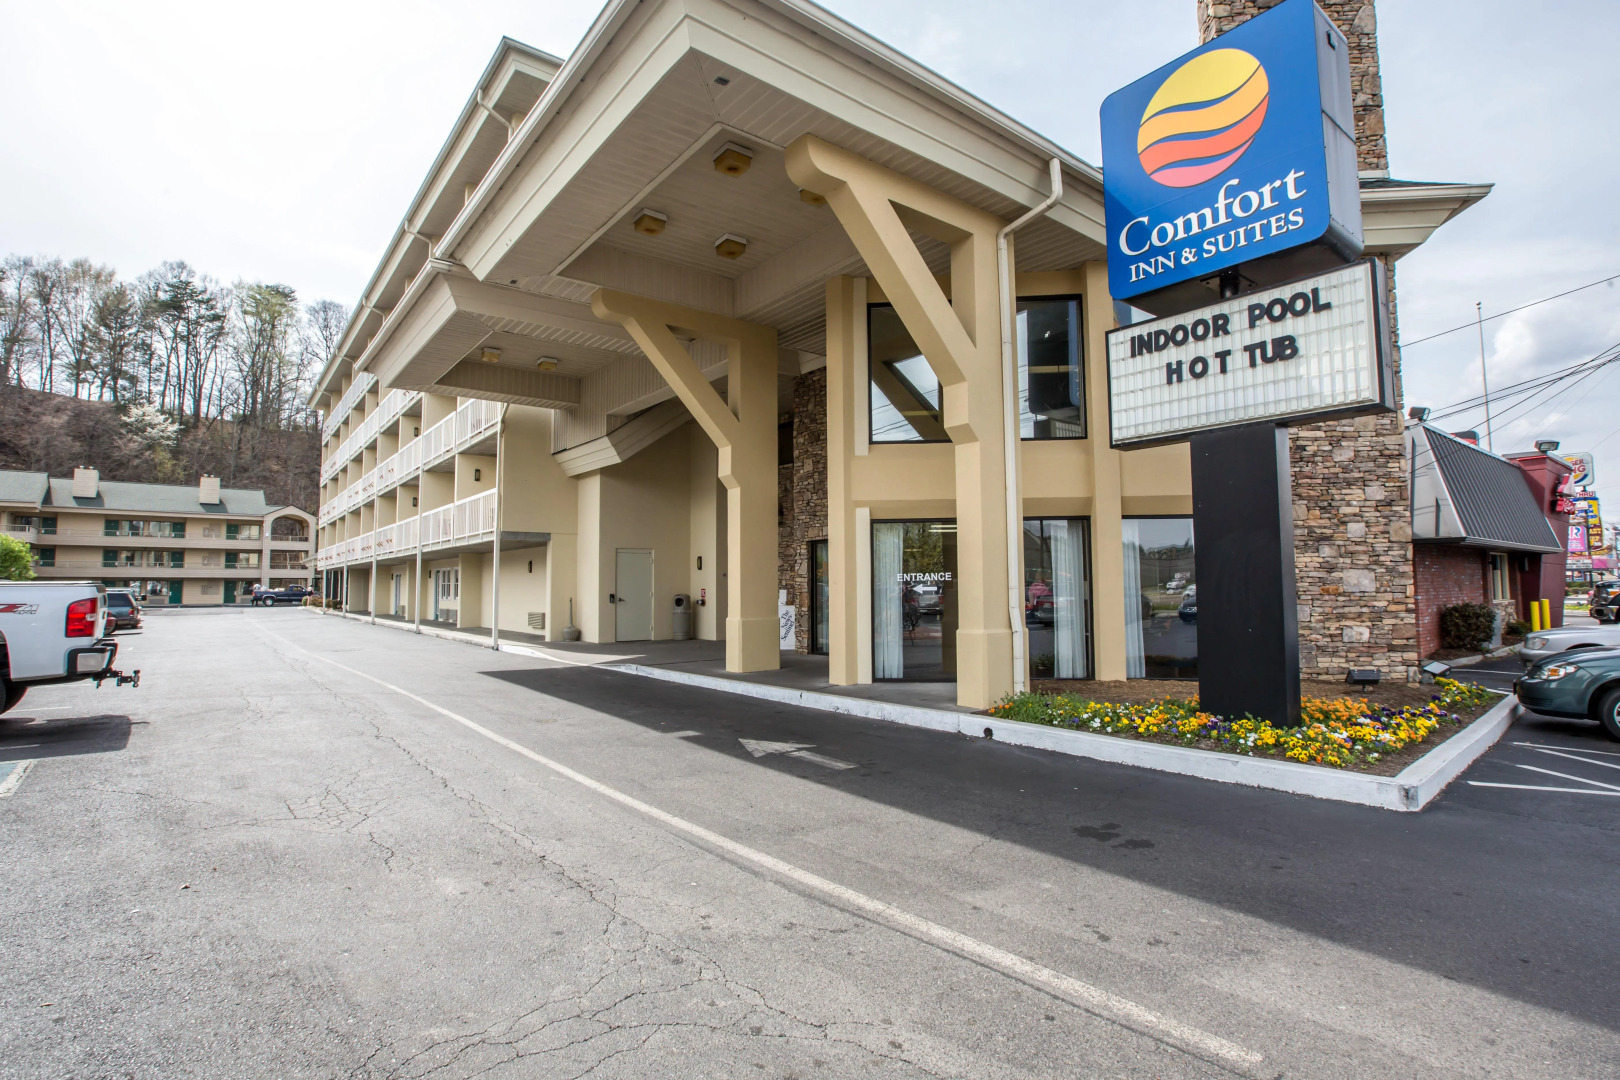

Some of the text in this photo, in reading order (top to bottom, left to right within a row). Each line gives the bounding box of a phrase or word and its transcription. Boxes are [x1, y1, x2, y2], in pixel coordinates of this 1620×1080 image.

[1119, 168, 1307, 256] Comfort
[1129, 207, 1305, 283] INN & SUITES
[1130, 286, 1332, 358] INDOOR POOL
[1165, 334, 1299, 385] HOT TUB
[896, 572, 952, 582] ENTRANCE
[780, 620, 795, 642] Sentinel
[781, 610, 790, 620] The
